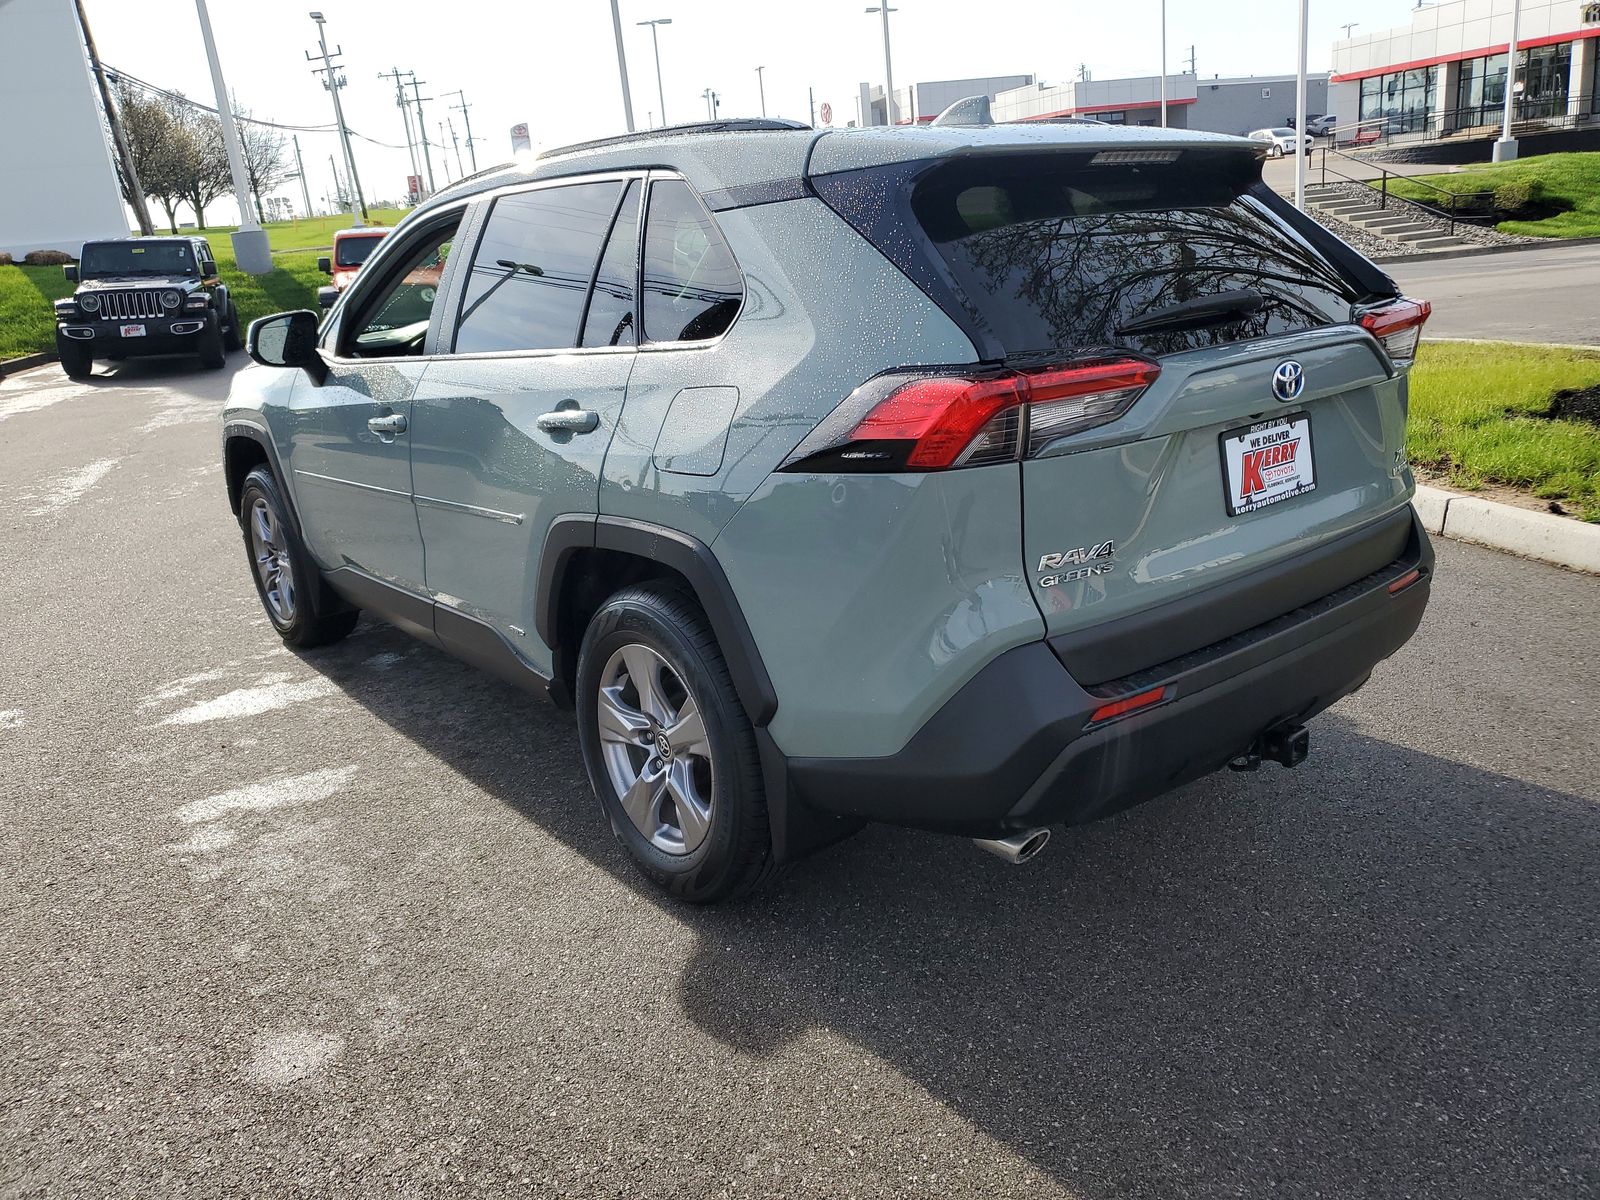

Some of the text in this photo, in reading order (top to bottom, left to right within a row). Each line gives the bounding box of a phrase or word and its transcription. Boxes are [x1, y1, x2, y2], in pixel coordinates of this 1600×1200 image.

[1250, 417, 1288, 433] RIGHT BY YOU
[1250, 430, 1290, 448] WE DELIVER
[1241, 440, 1299, 497] KERRY
[1273, 465, 1294, 476] TOYOTA
[1235, 483, 1316, 515] kerryautomotive.com
[1037, 539, 1115, 572] RAV4
